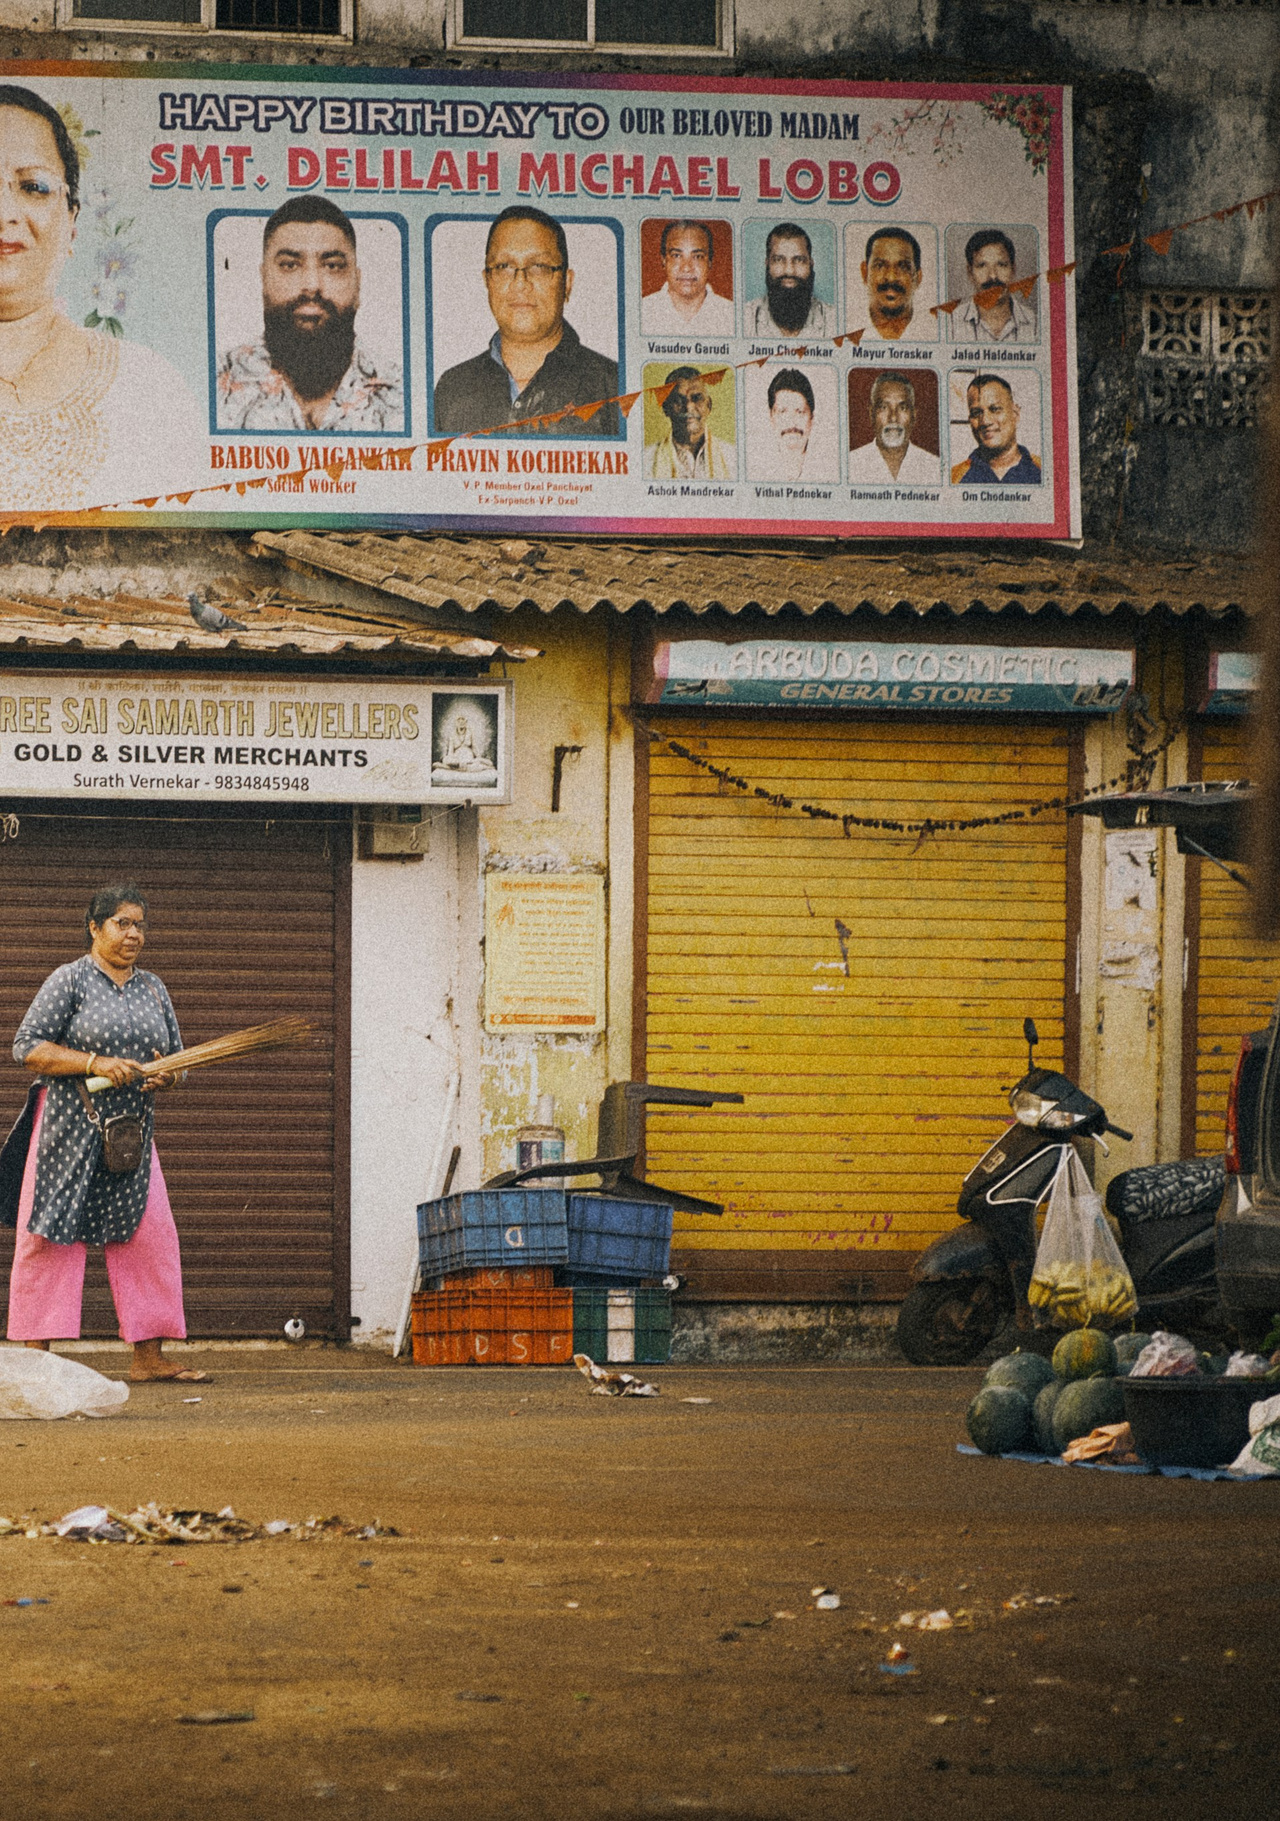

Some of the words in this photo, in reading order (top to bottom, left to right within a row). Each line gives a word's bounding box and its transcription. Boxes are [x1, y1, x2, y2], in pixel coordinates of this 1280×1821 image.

[159, 92, 317, 133] HAPPY
[319, 96, 542, 138] BIRTHDAY
[543, 101, 610, 140] TO
[620, 106, 665, 136] OUR
[673, 108, 773, 138] BELOVED
[780, 111, 860, 140] MADAM
[149, 143, 269, 191] SMT.
[287, 147, 499, 195] DELILAH
[517, 151, 742, 201] MICHAEL
[758, 158, 902, 207] LOBO
[648, 342, 691, 354] Vasudev
[694, 343, 730, 355] Garudi
[749, 344, 774, 355] Janu
[777, 344, 834, 357] Choankar
[852, 347, 885, 360] Mayur
[888, 347, 933, 359] Toraskar
[983, 349, 1037, 361] Haldankar
[210, 445, 290, 469] BABUSO
[427, 448, 499, 472] PRAVIN
[507, 450, 629, 475] KOCHREKAR
[485, 481, 521, 491] Member
[648, 485, 677, 497] Ashok
[681, 486, 734, 497] Mandrekar
[755, 487, 783, 498] Vithal
[786, 488, 832, 499] Pednekar
[850, 490, 892, 500] Ramnath
[895, 490, 939, 501] Pednekar
[962, 491, 978, 501] Om
[980, 491, 1031, 502] Chodankar
[729, 646, 879, 680] ARBUDA
[891, 649, 1077, 684] COSMETIC
[780, 683, 903, 701] GENERAL
[908, 685, 1014, 703] STORES
[61, 698, 108, 734] SAI
[117, 698, 254, 736] SAMARTH
[264, 701, 419, 740] JEWELLERS
[14, 743, 81, 762] GOLD
[92, 744, 108, 763] &
[118, 744, 205, 764] SILVER
[214, 747, 368, 767] MERCHANTS
[74, 773, 124, 788] Surath
[129, 774, 200, 789] Vernekar
[214, 775, 310, 791] 9834845948
